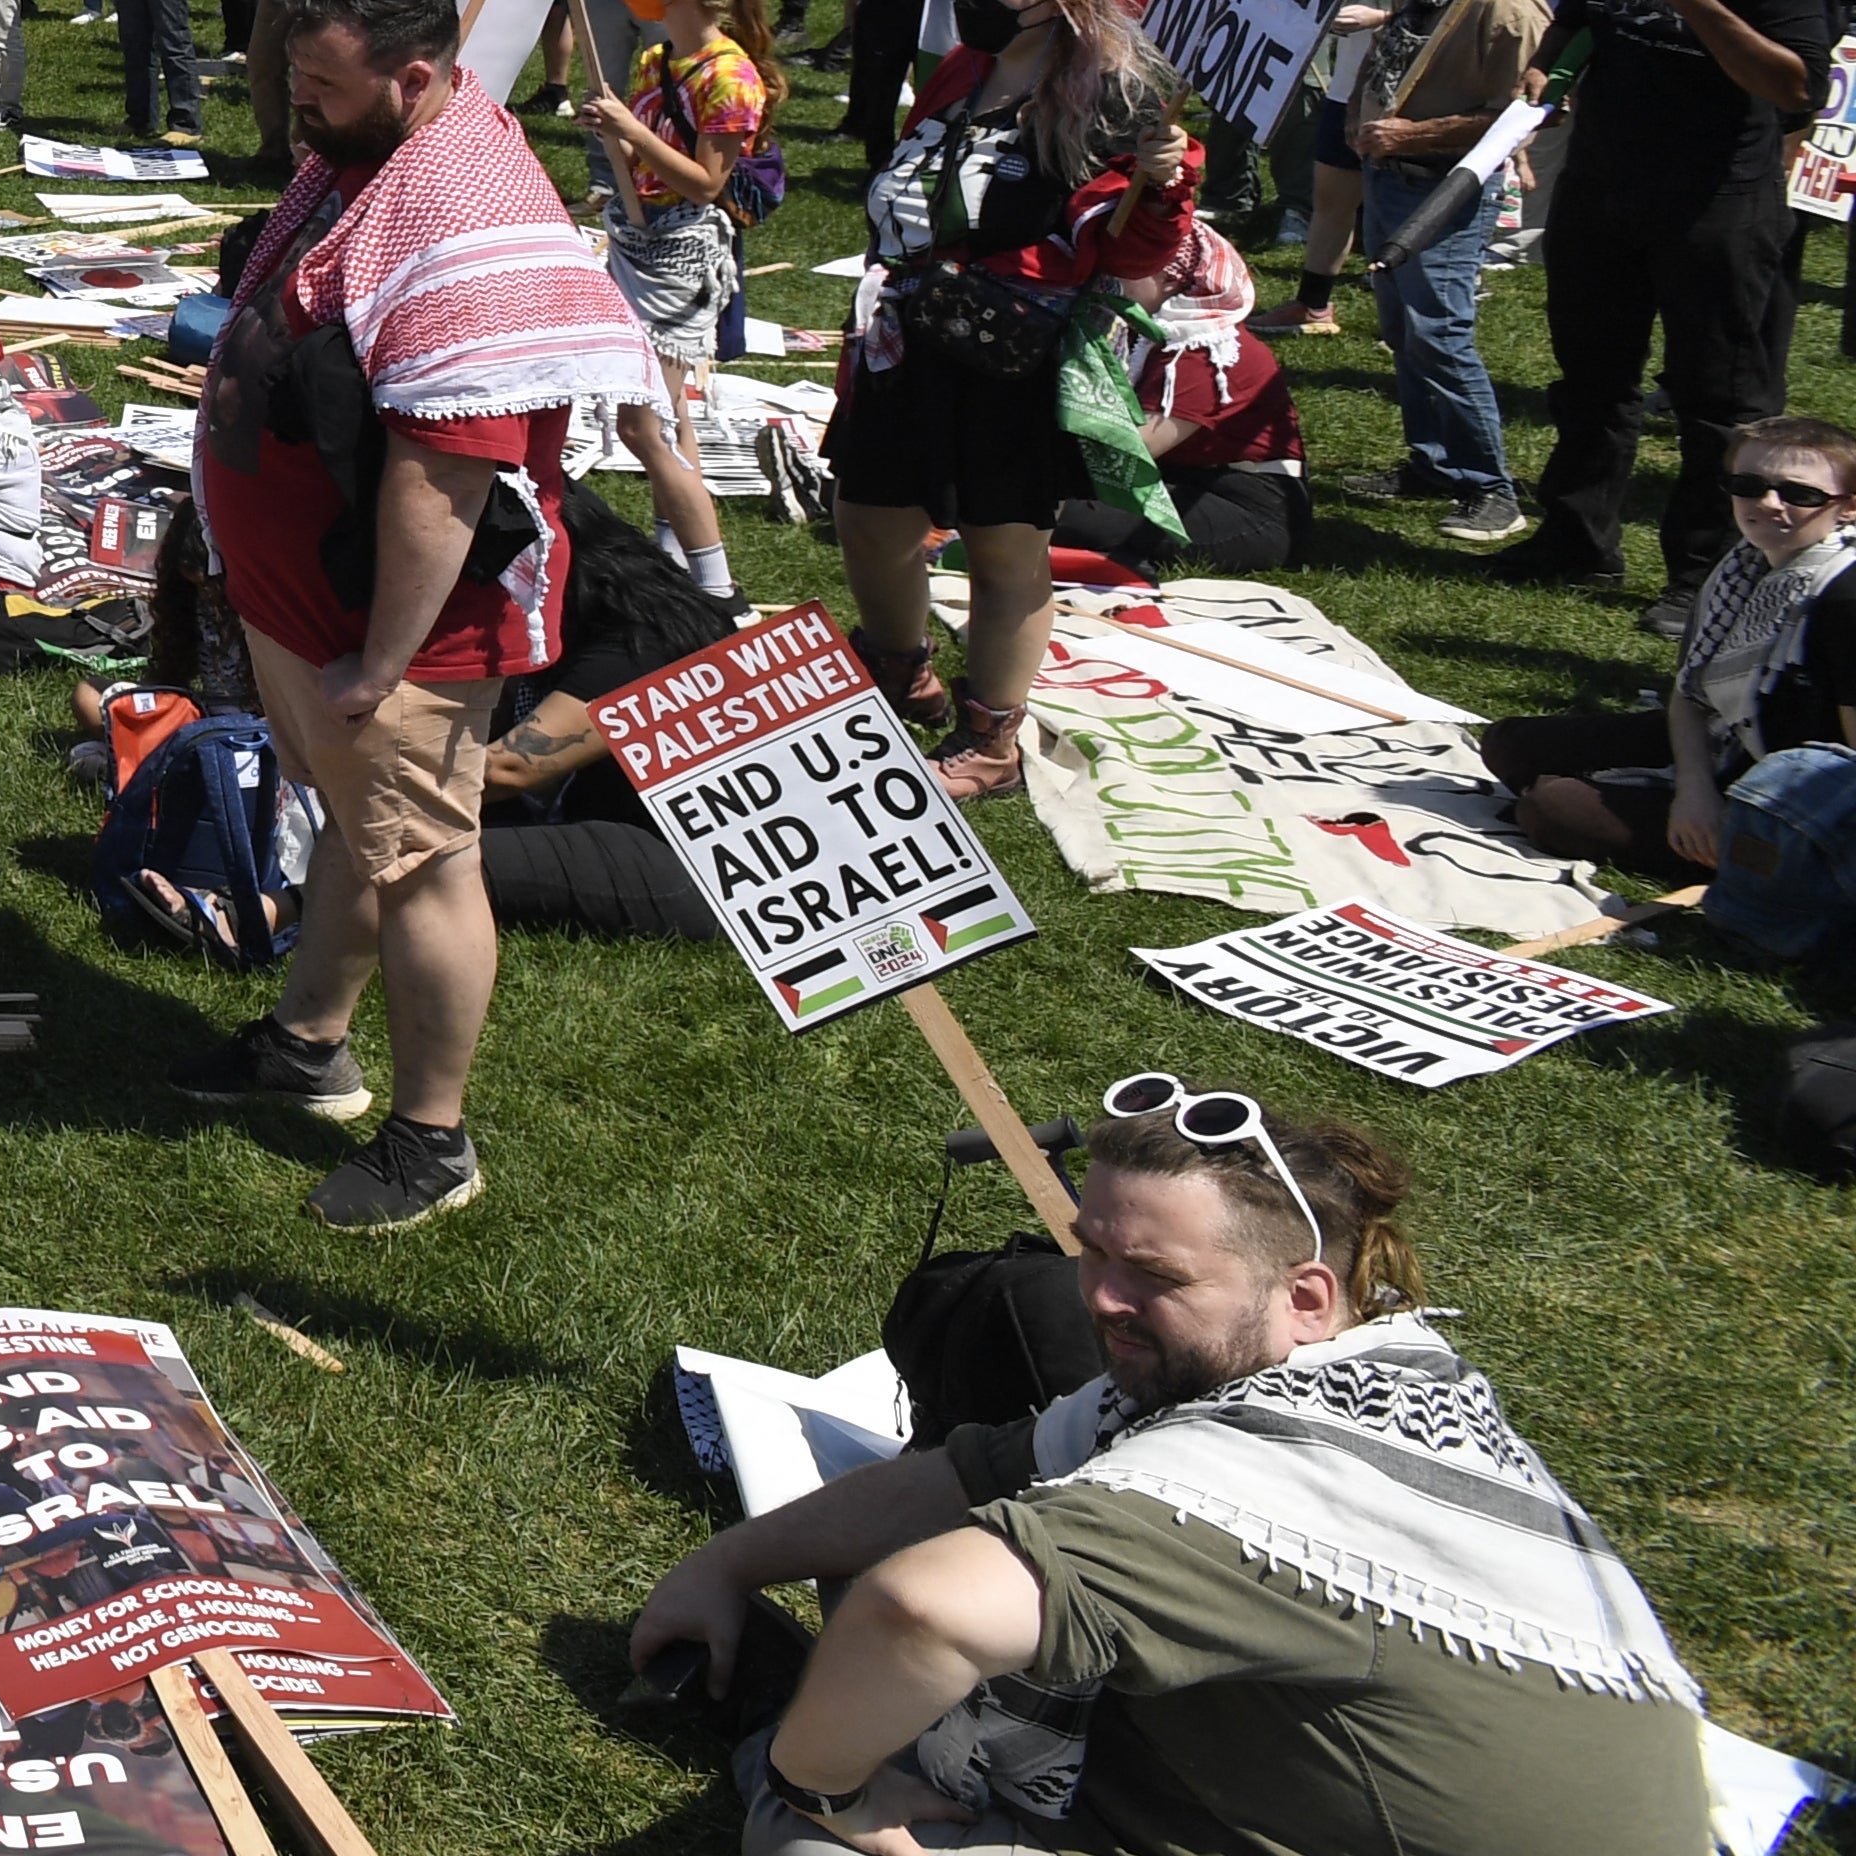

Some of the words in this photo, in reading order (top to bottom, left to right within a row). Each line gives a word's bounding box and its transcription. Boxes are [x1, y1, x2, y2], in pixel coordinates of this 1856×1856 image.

[598, 662, 725, 740] STAND
[727, 611, 833, 678] WITH
[620, 649, 861, 782] PALESTINE!
[666, 762, 782, 841] END
[790, 713, 890, 783] U.S
[711, 815, 820, 901] AID
[827, 767, 929, 839] TO
[737, 821, 973, 955] ISRAEL!
[874, 949, 923, 977] 2024
[1261, 930, 1566, 1037] PALESTINIAN
[1276, 986, 1348, 1013] THE
[1300, 915, 1608, 1023] RESISTANCE
[1153, 958, 1449, 1075] VICTORY
[1343, 1010, 1394, 1030] TO
[12, 1443, 110, 1483] TO
[35, 1406, 153, 1433] AID
[15, 1614, 93, 1653] MONEY
[95, 1594, 141, 1624] FOR
[143, 1580, 253, 1615] SCHOOLS,
[254, 1586, 314, 1610] JOBS,
[30, 1612, 177, 1673] HEALTHCARE,
[177, 1604, 199, 1625] &
[201, 1602, 290, 1624] HOUSING
[111, 1638, 160, 1672] NOT
[161, 1622, 280, 1650] GENOCIDE!
